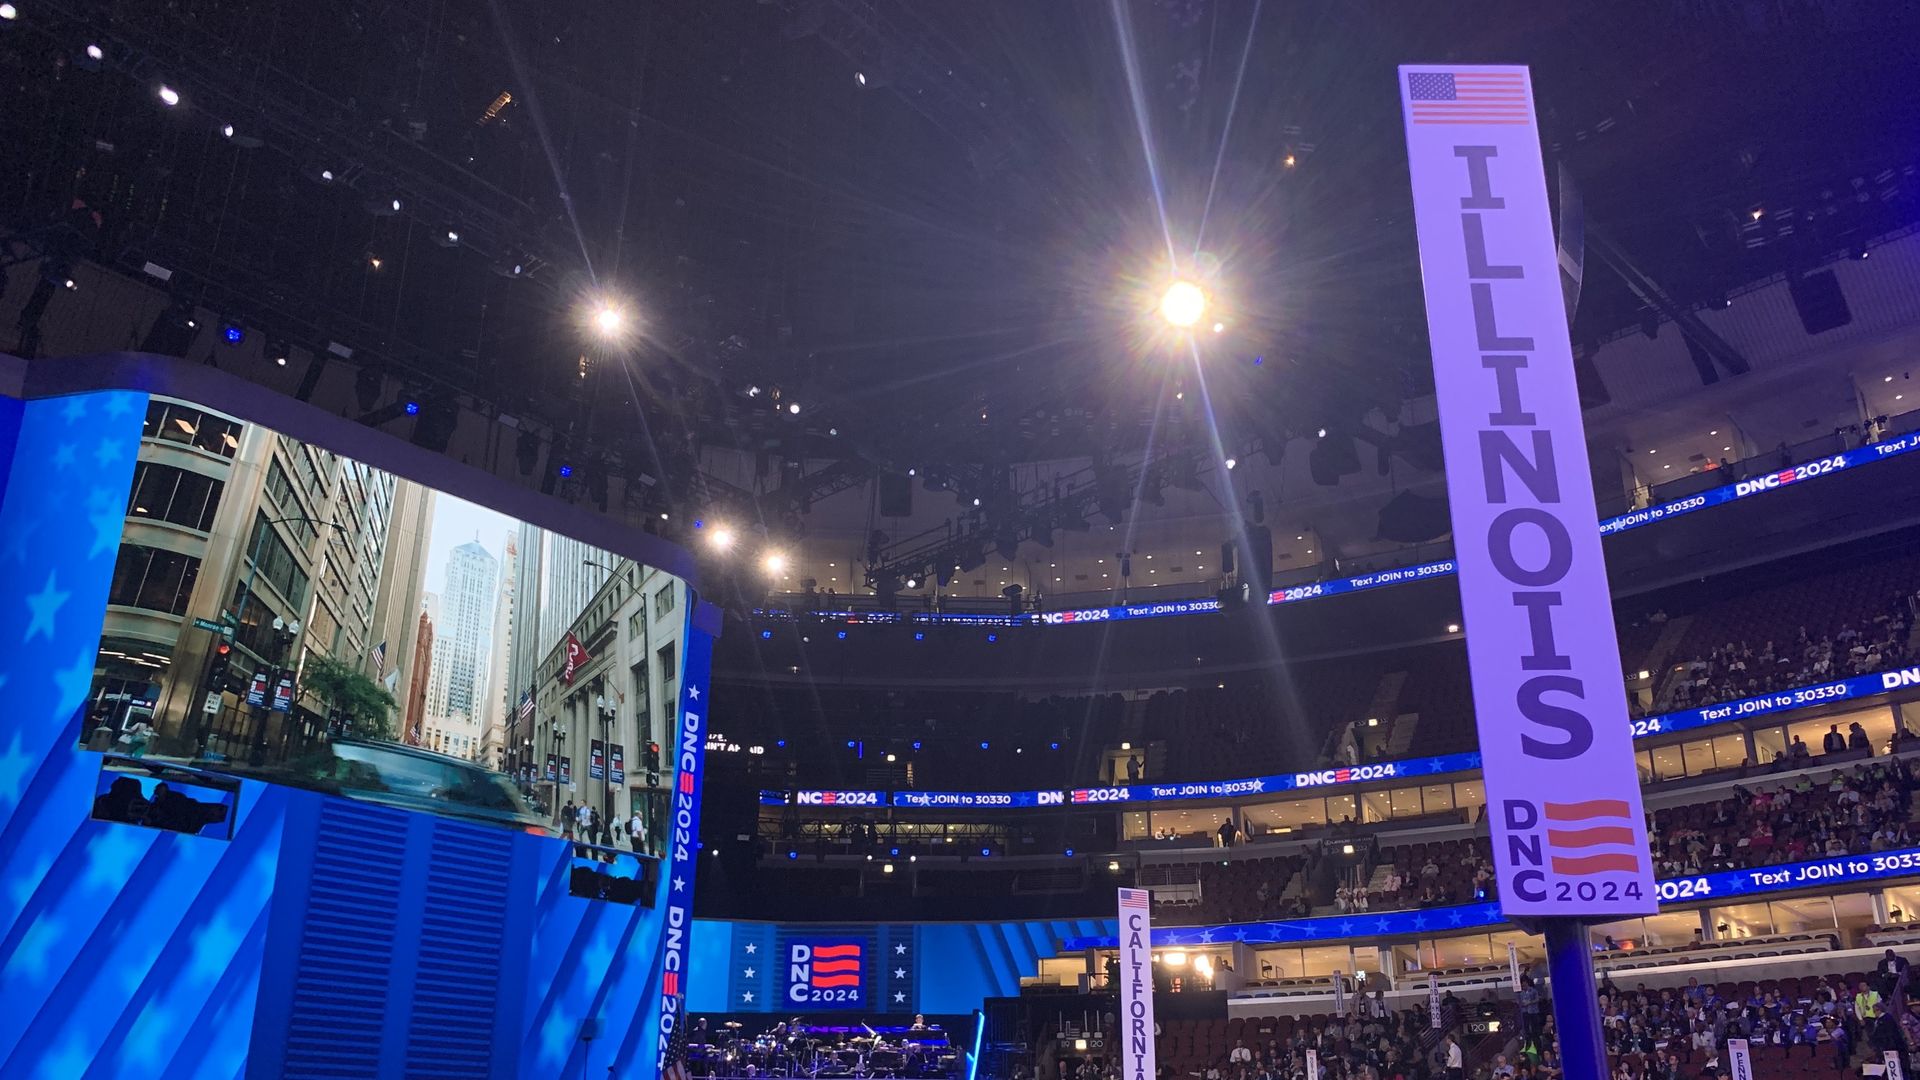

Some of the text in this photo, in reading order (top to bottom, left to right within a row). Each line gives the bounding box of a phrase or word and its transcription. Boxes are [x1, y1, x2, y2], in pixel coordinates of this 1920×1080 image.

[1453, 145, 1594, 760] ILLINOIS
[1875, 435, 1920, 455] Text J
[1795, 455, 1846, 480] 2024
[1600, 496, 1705, 533] ext JOIN to 30330
[1350, 562, 1452, 588] Text JOIN to 30330
[1285, 585, 1322, 600] 2024
[1075, 609, 1110, 621] 2024
[1127, 607, 1148, 616] Text
[1150, 605, 1174, 615] JOIN
[1177, 604, 1187, 612] to
[1700, 684, 1847, 721] Text JOIN to 30330
[1350, 764, 1395, 780] 2024
[674, 711, 699, 862] DNC 2024
[1088, 788, 1129, 801] 2024
[1152, 781, 1261, 797] Text JOIN to 30330
[836, 792, 877, 804] 2024
[905, 794, 1011, 804] Text JOIN to 30330
[1503, 799, 1548, 902] DNC
[1750, 869, 1791, 886] Text
[1796, 862, 1844, 881] JOIN
[1848, 860, 1868, 874] to
[1555, 881, 1643, 902] 2024
[665, 905, 684, 972] DNC
[790, 945, 811, 1002] DNC
[811, 989, 859, 1002] 2024
